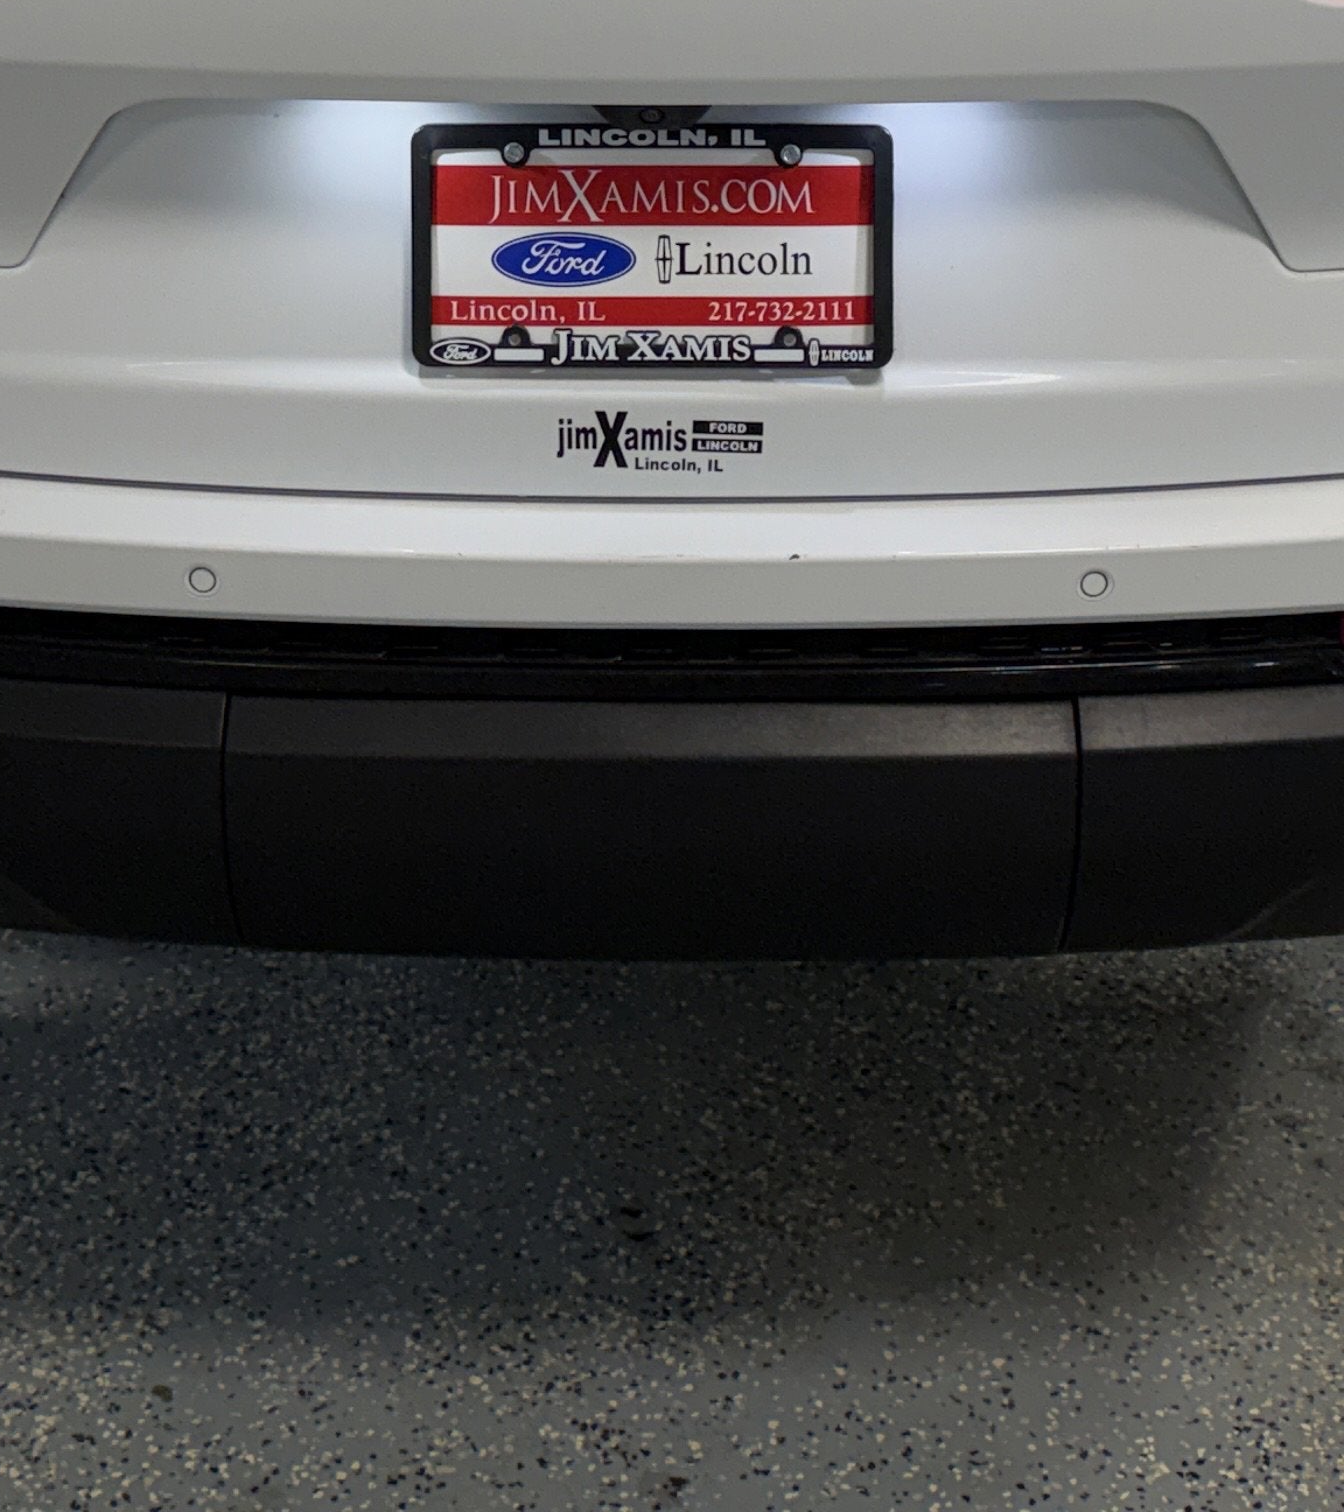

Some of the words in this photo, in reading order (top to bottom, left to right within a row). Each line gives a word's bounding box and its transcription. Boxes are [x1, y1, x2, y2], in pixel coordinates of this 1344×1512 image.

[538, 128, 720, 147] LINCOLN,
[730, 128, 767, 147] IL
[488, 168, 817, 225] JIMXAMIS.COM
[521, 239, 608, 277] Ford
[674, 241, 814, 276] Lincoln
[450, 299, 566, 323] Lincoln,
[577, 300, 607, 322] IL
[707, 301, 856, 323] 217-732-2111
[551, 328, 621, 366] JIM
[626, 330, 752, 363] XAMIS
[821, 349, 875, 362] LINCOLN
[709, 422, 748, 434] FORD
[697, 440, 760, 452] LINCOLN
[634, 458, 702, 475] Lincoln,
[707, 459, 725, 473] IL
